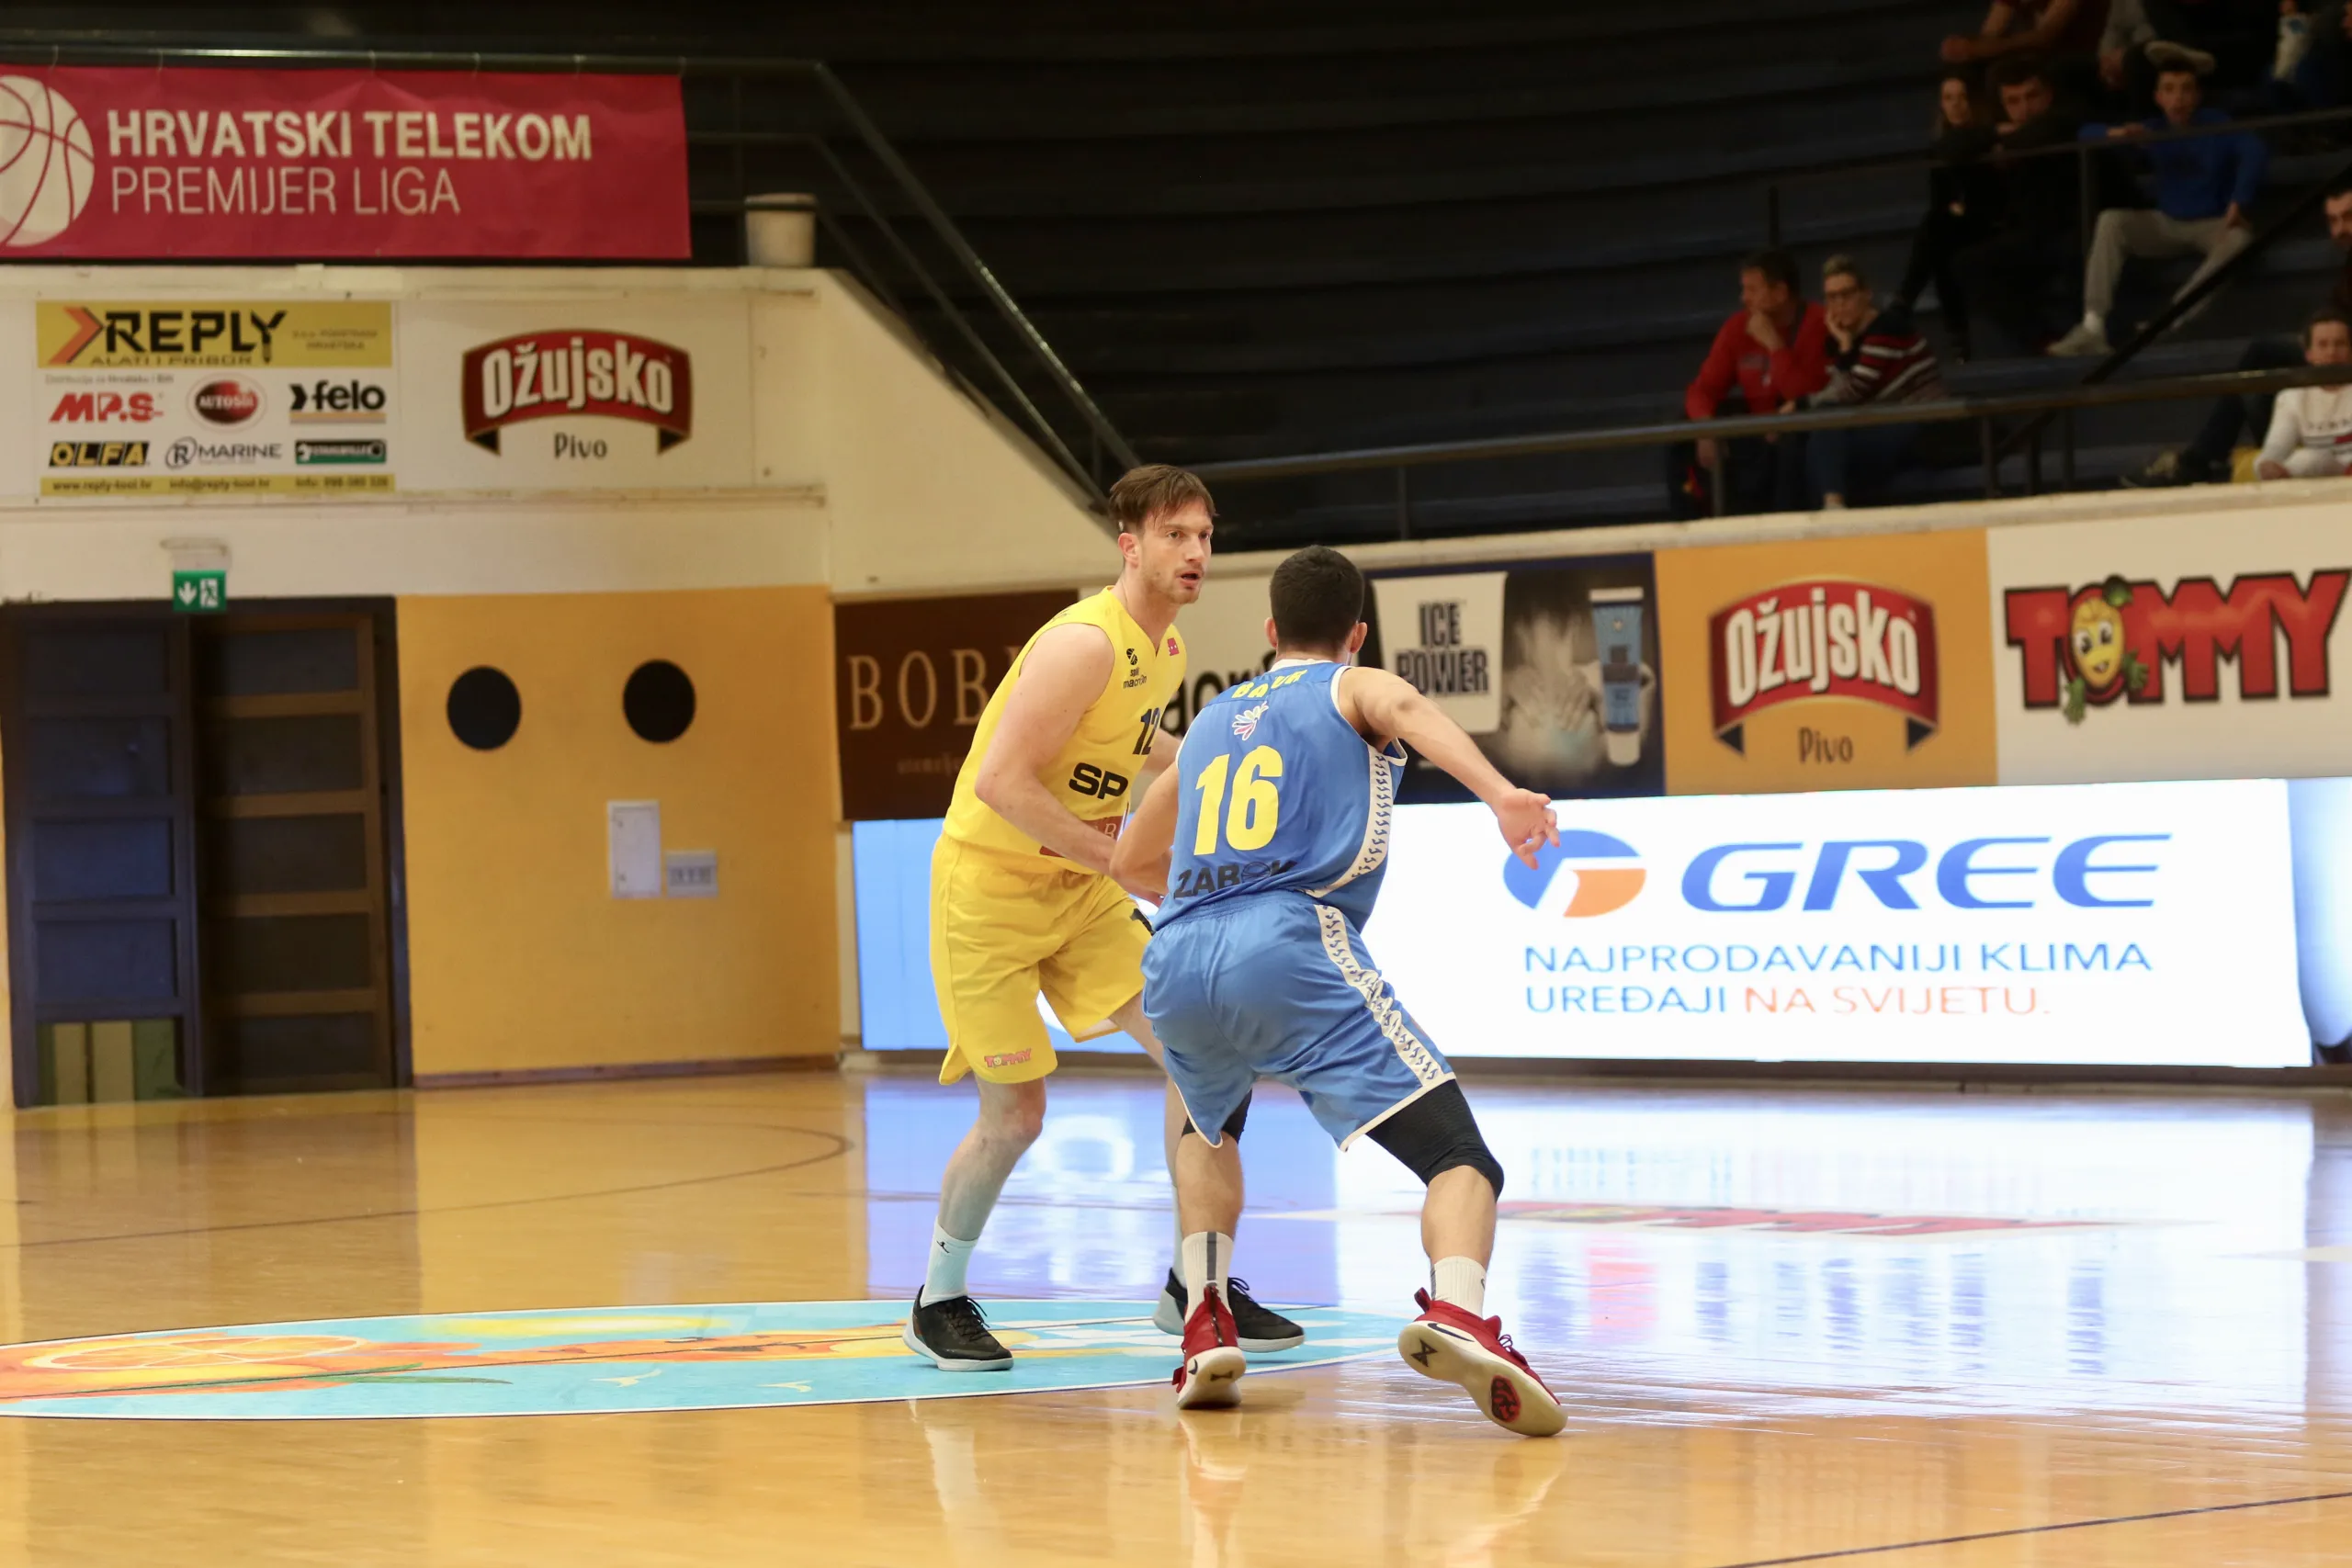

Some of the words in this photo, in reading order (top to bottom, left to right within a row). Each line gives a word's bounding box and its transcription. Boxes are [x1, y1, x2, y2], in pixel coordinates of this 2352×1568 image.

[107, 109, 352, 159] HRVATSKI
[365, 110, 593, 160] TELEKOM
[111, 166, 337, 216] PREMIJER
[353, 166, 461, 215] LIGA
[105, 310, 287, 364] REPLY
[312, 379, 386, 410] felo
[482, 336, 673, 418] Ožujsko
[50, 442, 150, 466] OLFA
[198, 443, 283, 458] MARINE
[554, 433, 607, 458] Pivo
[1419, 603, 1461, 646] ICE
[1725, 587, 1920, 706] Ožujsko
[2004, 567, 2352, 710] TOMMY
[1396, 649, 1488, 694] POWER
[1132, 707, 1160, 755] 12
[1799, 728, 1854, 763] Pivo
[1069, 761, 1128, 799] SP
[1193, 745, 1283, 855] 16
[1680, 834, 2172, 913] GREE
[1524, 943, 1961, 973] NAJPRODAVANIJI
[1981, 942, 2153, 972] KLIMA
[1526, 986, 1725, 1013] UREĐAJI
[1745, 986, 1816, 1013] NA
[1833, 986, 2050, 1015] SVIJETU.
